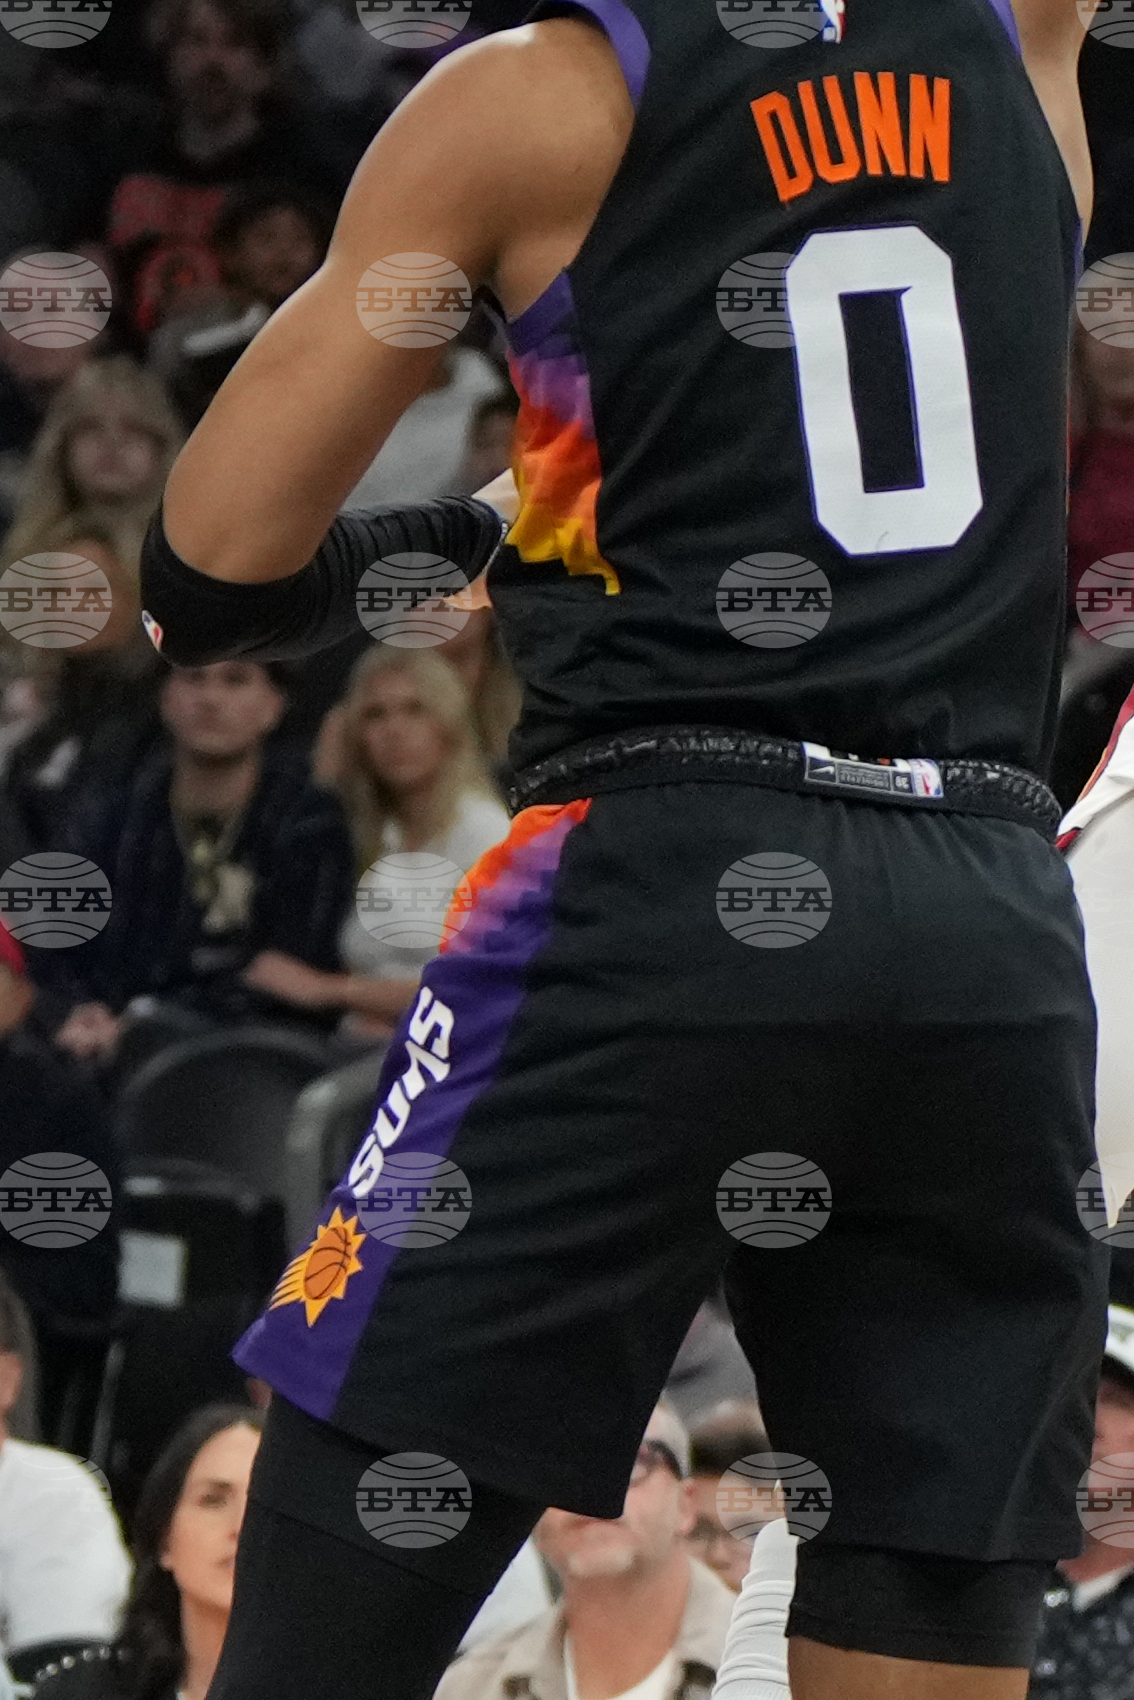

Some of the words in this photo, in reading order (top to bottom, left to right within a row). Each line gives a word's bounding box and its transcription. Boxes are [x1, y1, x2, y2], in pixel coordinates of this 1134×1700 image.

[750, 71, 950, 203] DUNN
[786, 223, 984, 556] 0
[348, 986, 455, 1199] SUNS
